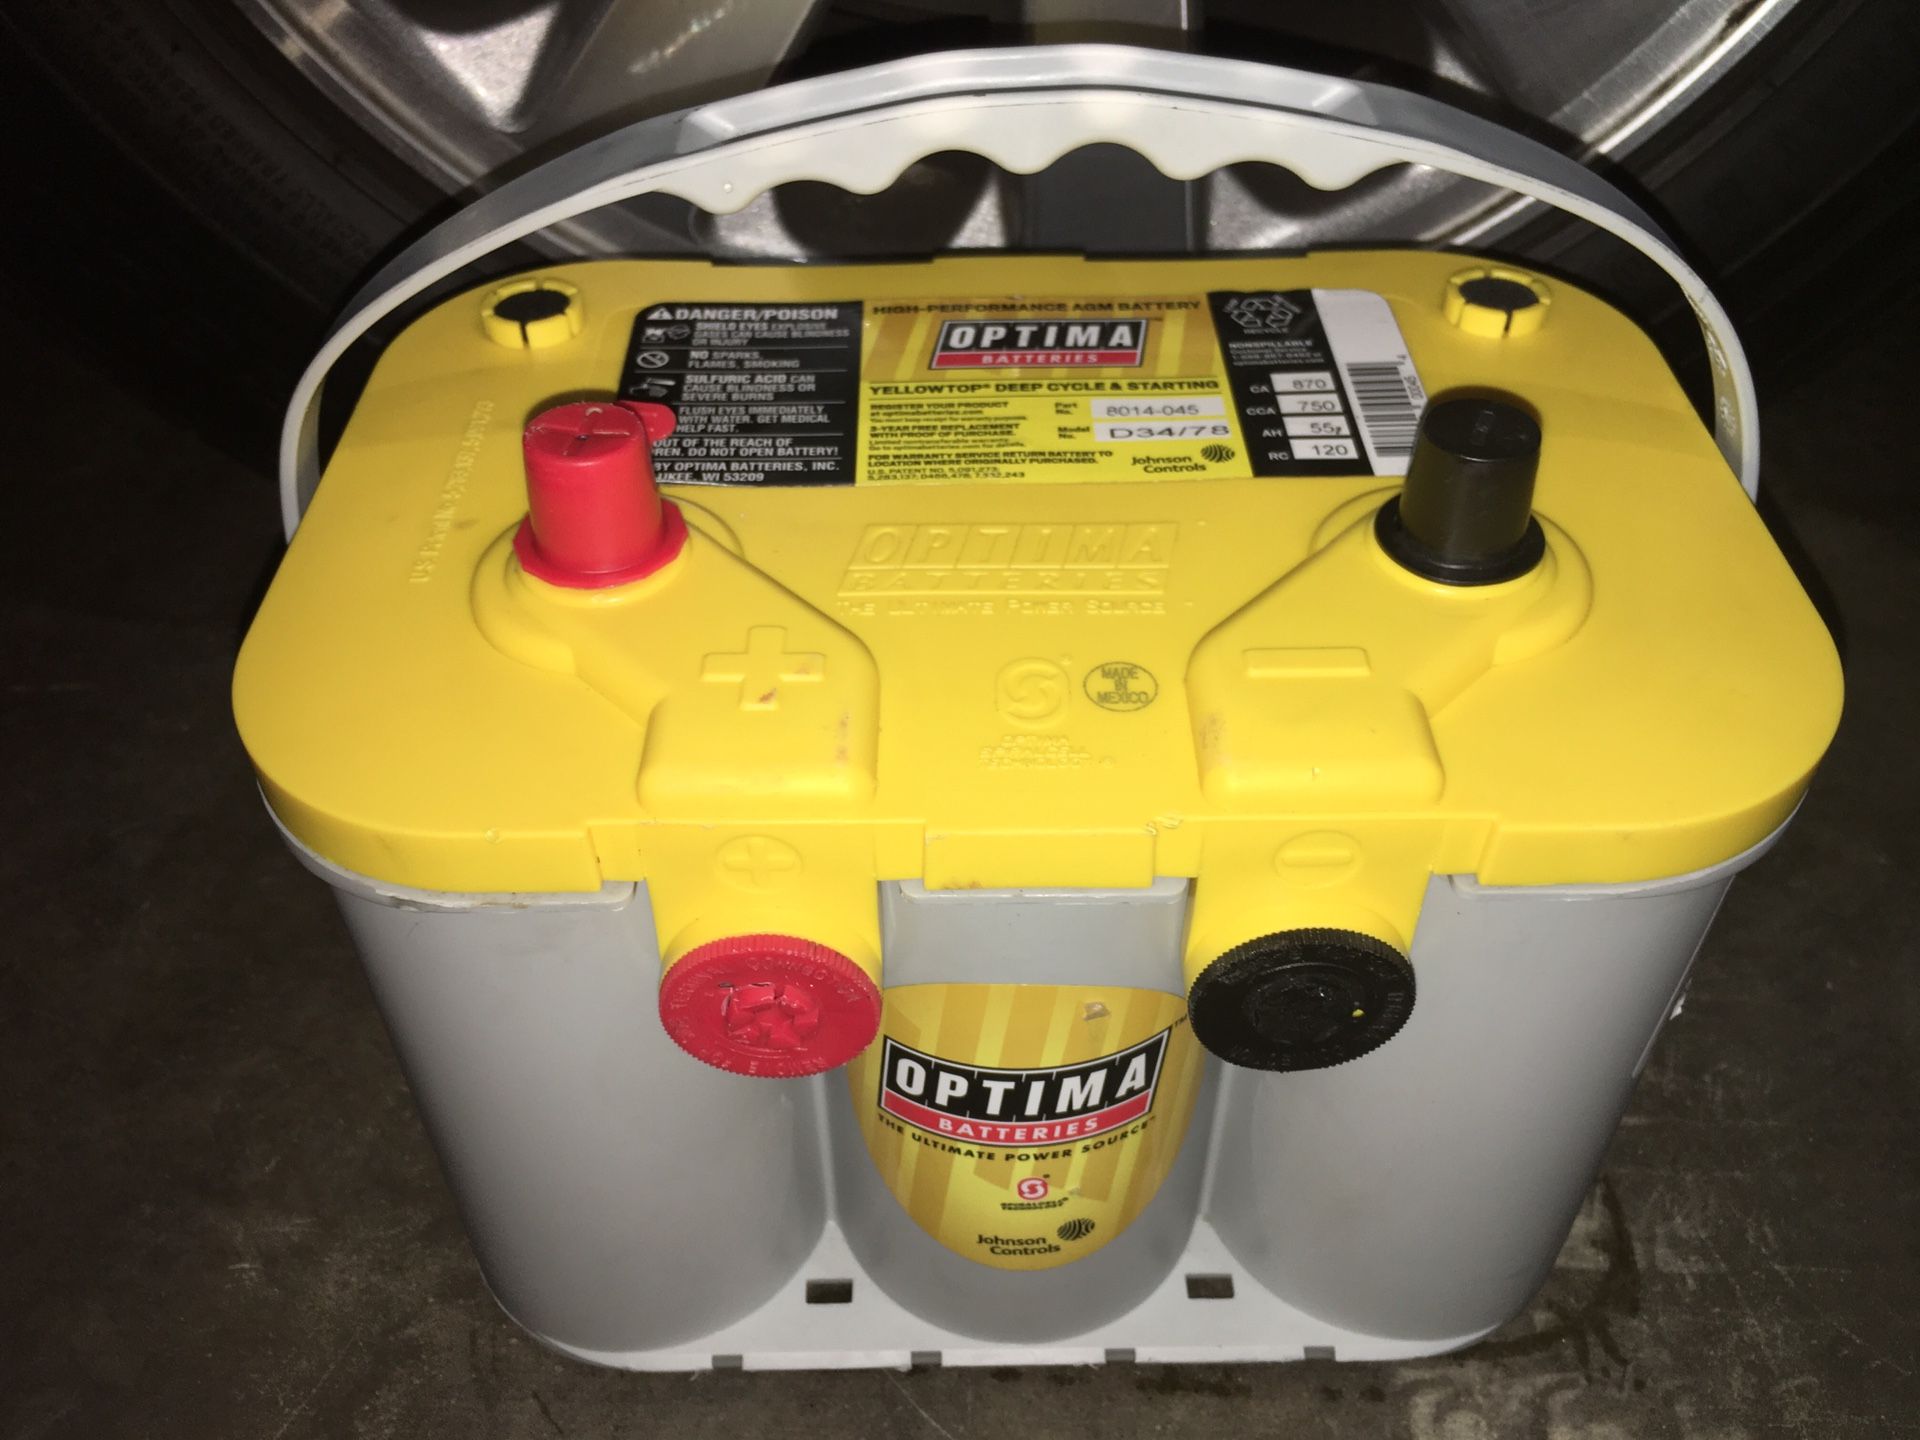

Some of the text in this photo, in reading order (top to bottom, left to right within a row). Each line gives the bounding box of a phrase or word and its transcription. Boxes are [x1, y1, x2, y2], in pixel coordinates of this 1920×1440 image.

[1073, 303, 1112, 311] AGM
[1118, 301, 1200, 311] BATTERY
[675, 308, 838, 320] DANGER/POISON
[738, 321, 768, 331] EYES
[948, 325, 1133, 349] OPTIMA
[689, 350, 709, 360] NO
[981, 354, 1098, 364] BATTERIES
[743, 359, 800, 369] SMOKING
[685, 374, 816, 384] SULFURIC ACID CAN
[683, 383, 816, 393] CAUSE BLINDNESS OR
[995, 382, 1043, 392] DEEP
[1047, 382, 1105, 391] CYCLE
[1109, 382, 1122, 391] &
[1127, 381, 1219, 390] STARTING
[1250, 379, 1326, 393] CA 870
[681, 392, 774, 402] SEVERE BURNS
[679, 405, 825, 415] FLUSH EYES IMMEDIATELY
[1106, 405, 1199, 417] 8014-045
[1246, 400, 1335, 416] CCA 750
[678, 415, 708, 424] WITH
[757, 415, 778, 424] GET
[781, 414, 830, 423] MEDICAL
[676, 424, 706, 433] HELP
[940, 423, 1019, 431] REPLACEMENT
[1109, 425, 1230, 439] D34/78
[1262, 429, 1283, 438] AH
[653, 438, 794, 447] OUT OF THE REACH OF
[687, 447, 707, 457] DO
[709, 447, 737, 457] NOT
[739, 447, 774, 457] OPEN
[777, 446, 839, 456] BATTERY!
[1268, 444, 1348, 461] RC 120
[674, 462, 728, 471] OPTIMA
[812, 461, 840, 471] INC.
[1131, 456, 1192, 465] Johnson
[1143, 464, 1207, 474] Controls
[701, 472, 720, 482] WI
[723, 472, 765, 482] 53209
[864, 525, 1162, 564] OPTIMA
[850, 571, 1160, 590] BATTERIES
[1101, 666, 1139, 680] MADE
[1114, 679, 1128, 691] IN
[1096, 690, 1150, 704] MEXICO
[895, 1052, 1147, 1116] OPTIMA
[938, 1117, 1098, 1141] BATTERIES
[878, 1113, 904, 1134] THE
[911, 1132, 996, 1161] ULTIMATE
[1004, 1148, 1072, 1161] POWER
[976, 1234, 1047, 1245] Johnson
[989, 1243, 1061, 1256] Controls
